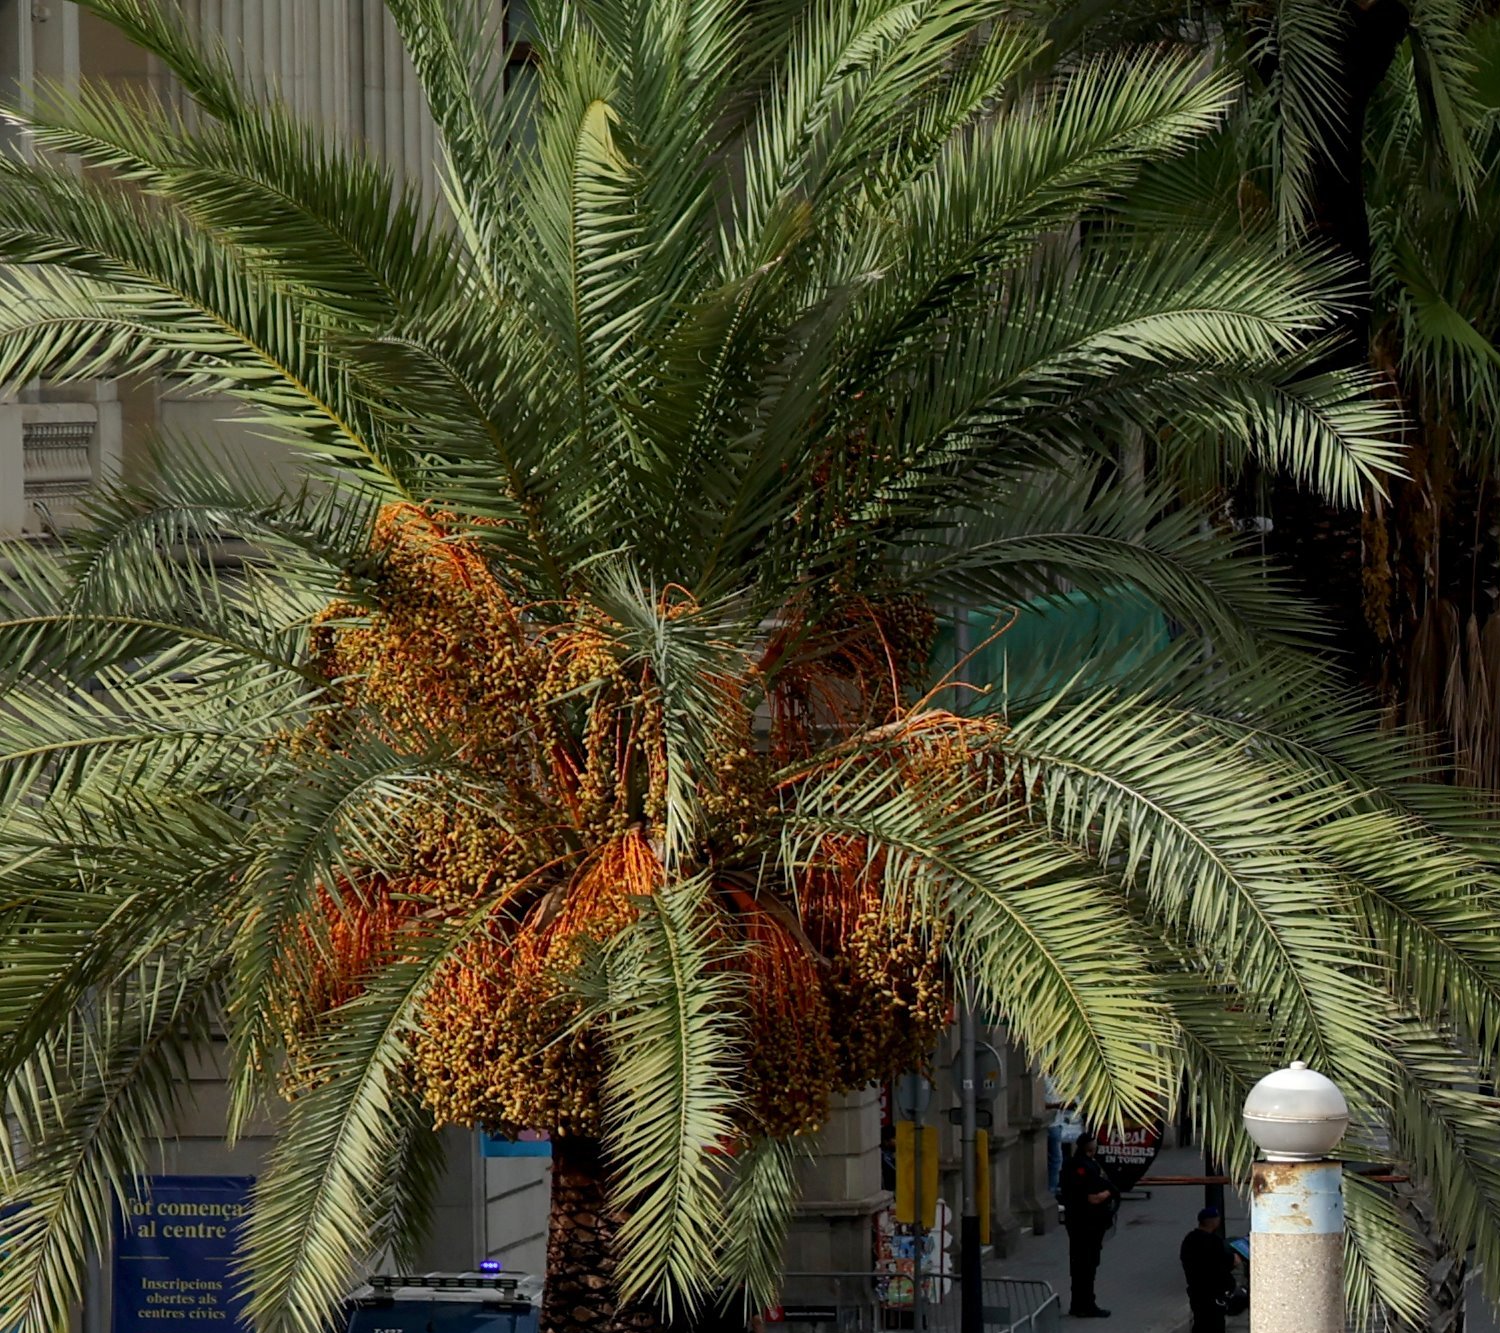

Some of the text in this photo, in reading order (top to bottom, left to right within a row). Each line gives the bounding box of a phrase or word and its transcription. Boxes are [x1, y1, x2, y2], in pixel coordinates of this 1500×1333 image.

[1097, 1145, 1155, 1157] BURGERS
[1105, 1156, 1146, 1165] IN TOWN
[158, 1201, 243, 1221] comença
[137, 1221, 226, 1239] al centre
[142, 1277, 223, 1292] Inscripcions
[146, 1292, 217, 1304] obertes als
[138, 1306, 227, 1319] centres cívics
